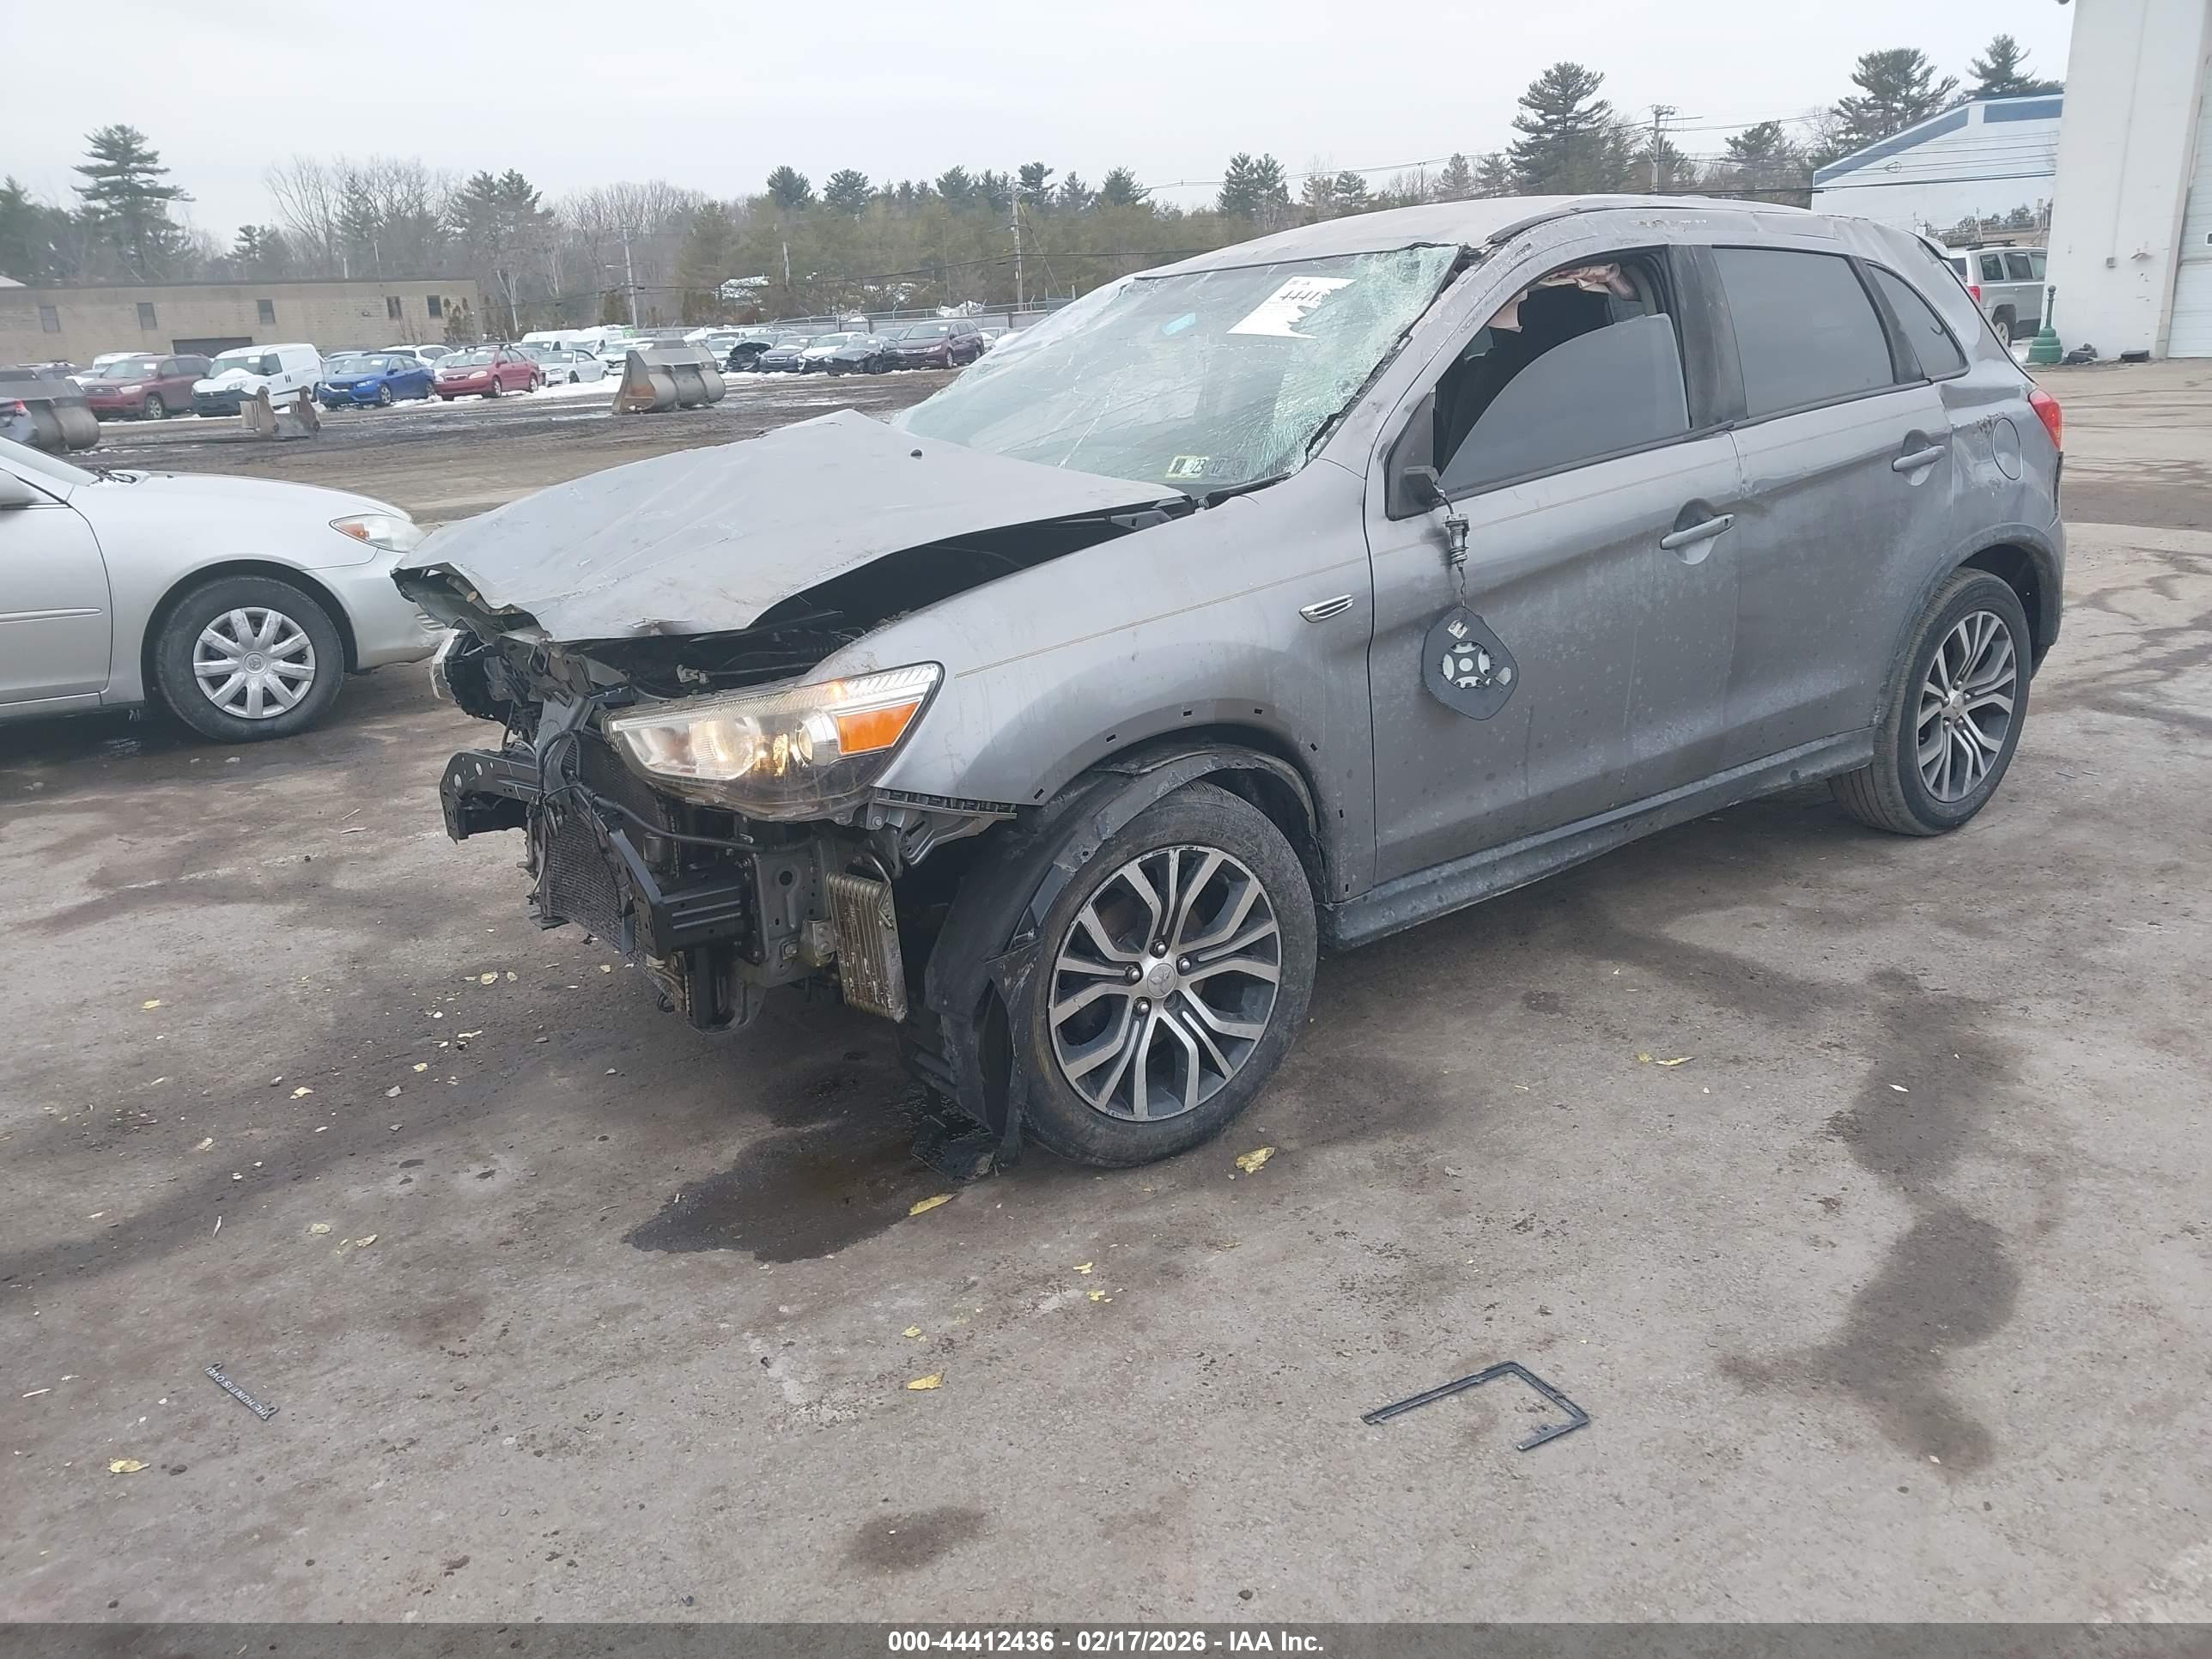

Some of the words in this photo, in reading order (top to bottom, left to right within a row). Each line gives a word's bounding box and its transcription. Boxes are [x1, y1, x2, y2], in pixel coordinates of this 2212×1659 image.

[1191, 459, 1206, 474] 23
[222, 1381, 234, 1389] IS
[228, 1388, 256, 1407] HUNT
[255, 1404, 269, 1419] THE
